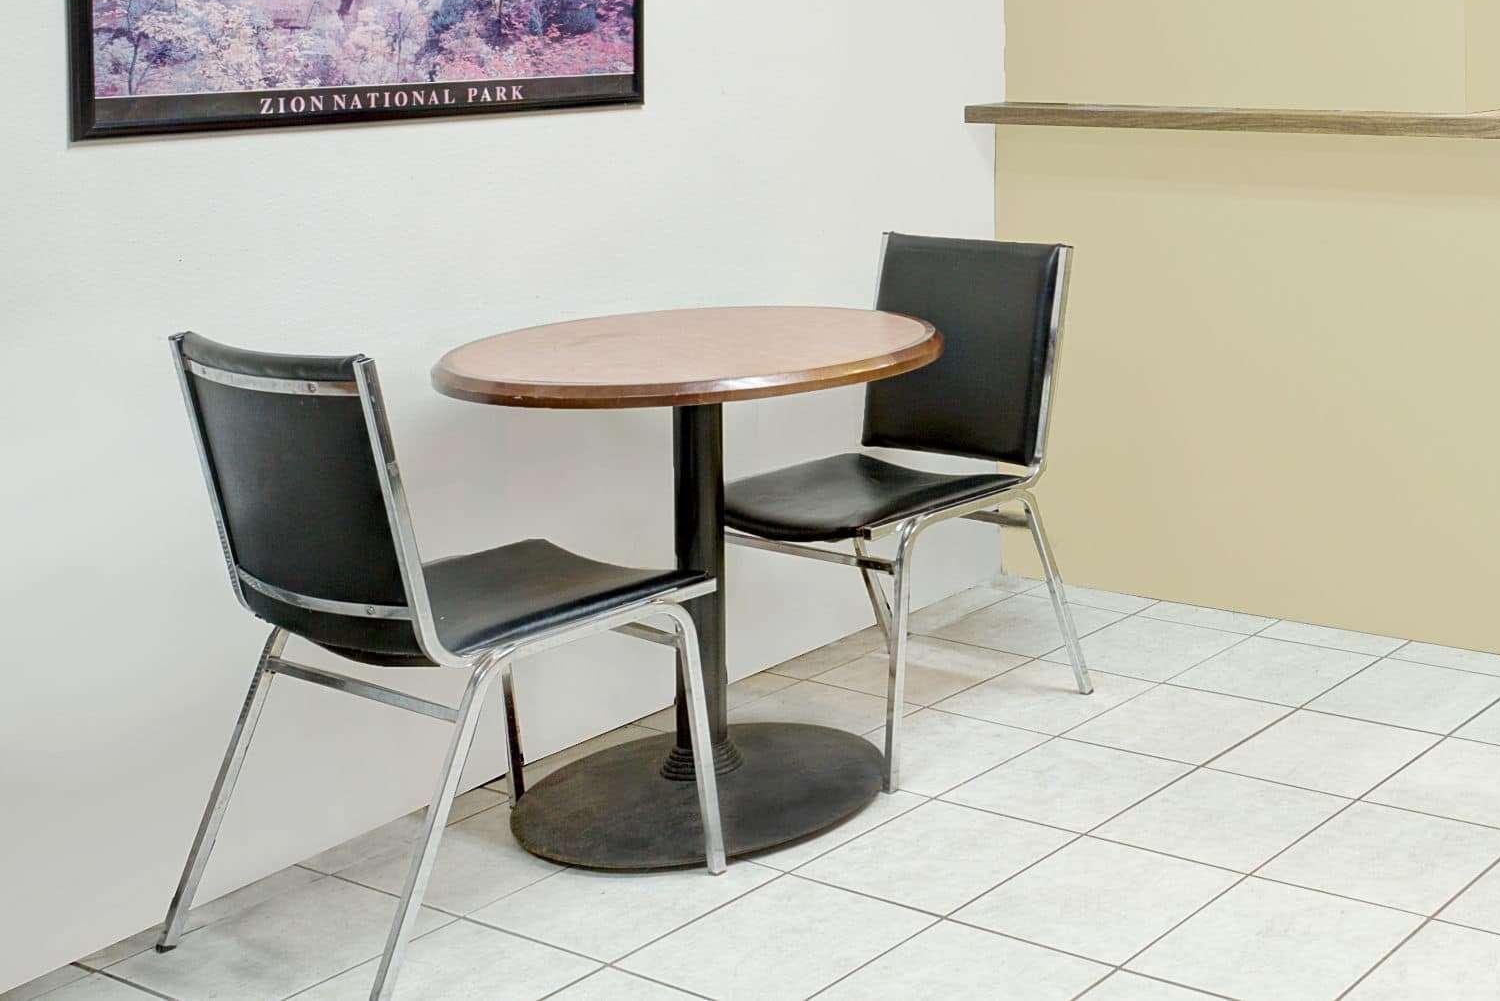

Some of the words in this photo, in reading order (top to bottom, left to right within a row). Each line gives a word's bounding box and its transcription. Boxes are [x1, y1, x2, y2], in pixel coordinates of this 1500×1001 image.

[260, 94, 324, 114] ZION
[333, 88, 455, 111] NATIONAL
[467, 85, 524, 103] PARK
